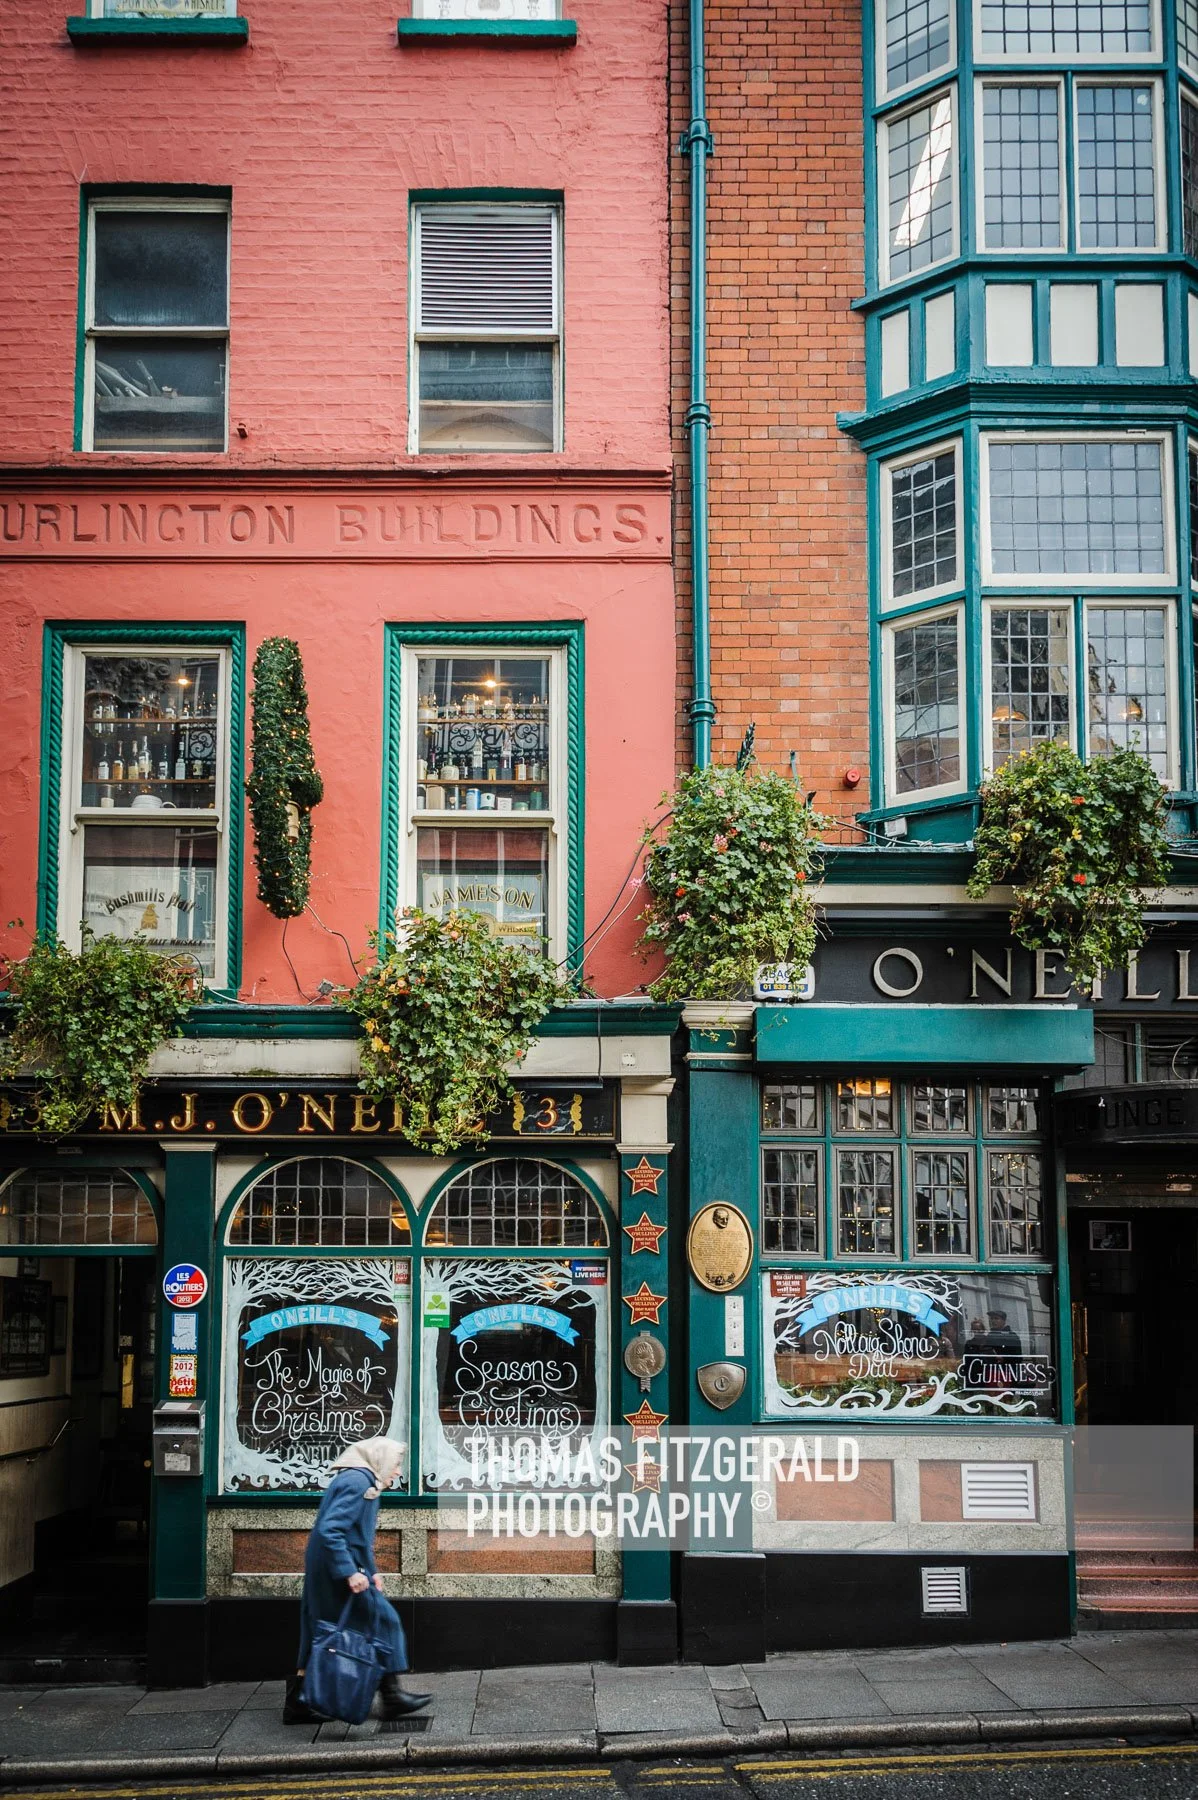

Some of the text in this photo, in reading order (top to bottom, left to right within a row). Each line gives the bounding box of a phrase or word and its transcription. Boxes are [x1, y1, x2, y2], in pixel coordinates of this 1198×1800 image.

[105, 888, 165, 914] Bushmills
[430, 884, 535, 910] JAMESON
[537, 1097, 558, 1129] 3
[166, 1283, 203, 1293] ROUTIERS
[177, 1273, 190, 1281] LES
[824, 1289, 923, 1314] O'NEILL'S
[271, 1306, 359, 1329] O'NEILL'S
[474, 1305, 560, 1328] O'NEILL'S
[813, 1318, 940, 1361] Nollaig Shona
[175, 1363, 193, 1371] 2012
[245, 1347, 387, 1397] The Magic of
[456, 1340, 577, 1394] Seasons
[968, 1359, 1047, 1384] GUINNESS
[252, 1391, 385, 1443] Christmas
[459, 1386, 581, 1453] Greetings
